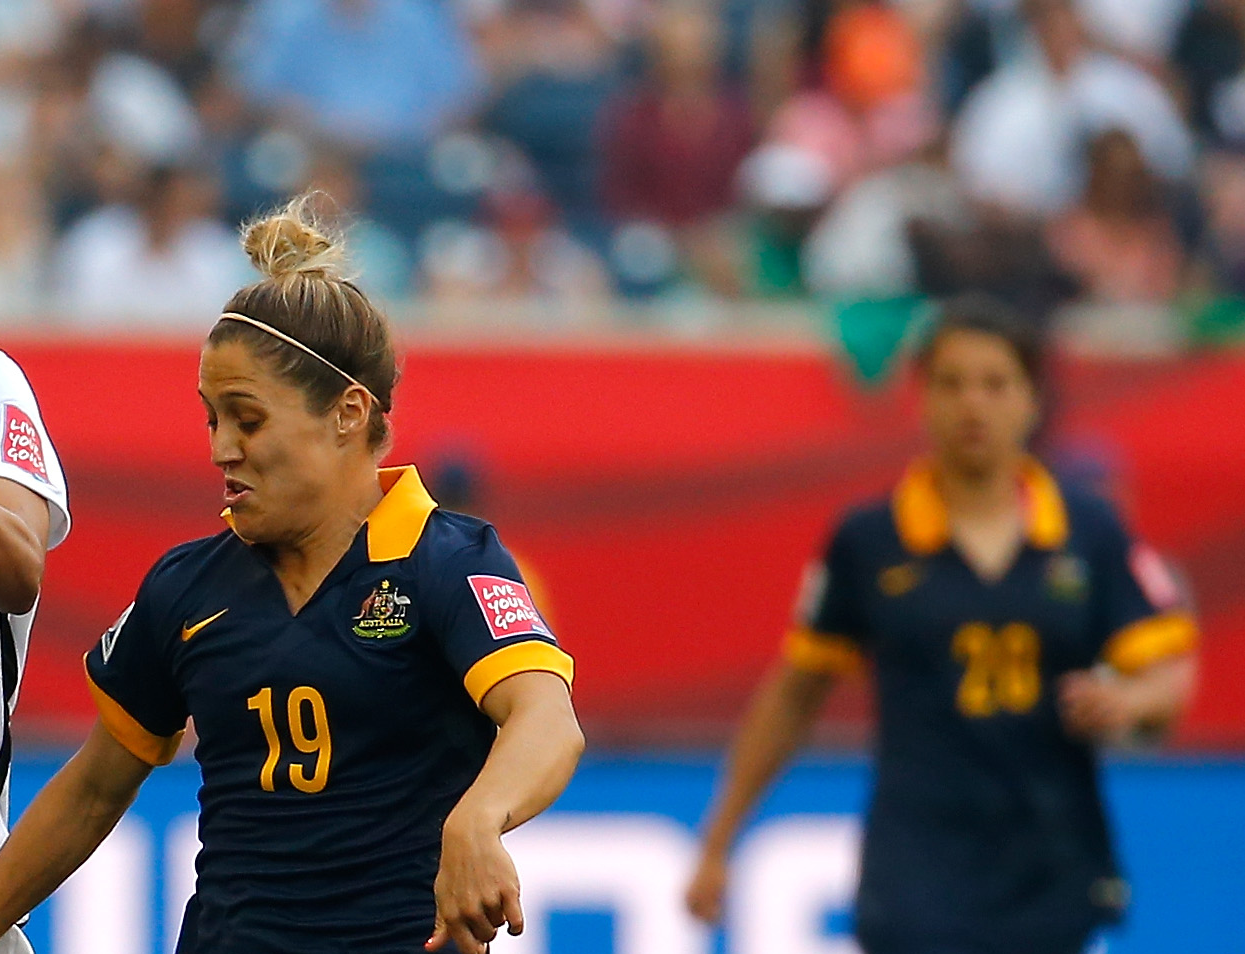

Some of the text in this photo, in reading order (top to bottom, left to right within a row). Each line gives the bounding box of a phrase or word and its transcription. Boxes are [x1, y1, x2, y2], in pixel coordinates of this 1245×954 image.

[482, 584, 516, 600] LIVE
[487, 596, 531, 615] YOUR
[247, 686, 333, 794] 19
